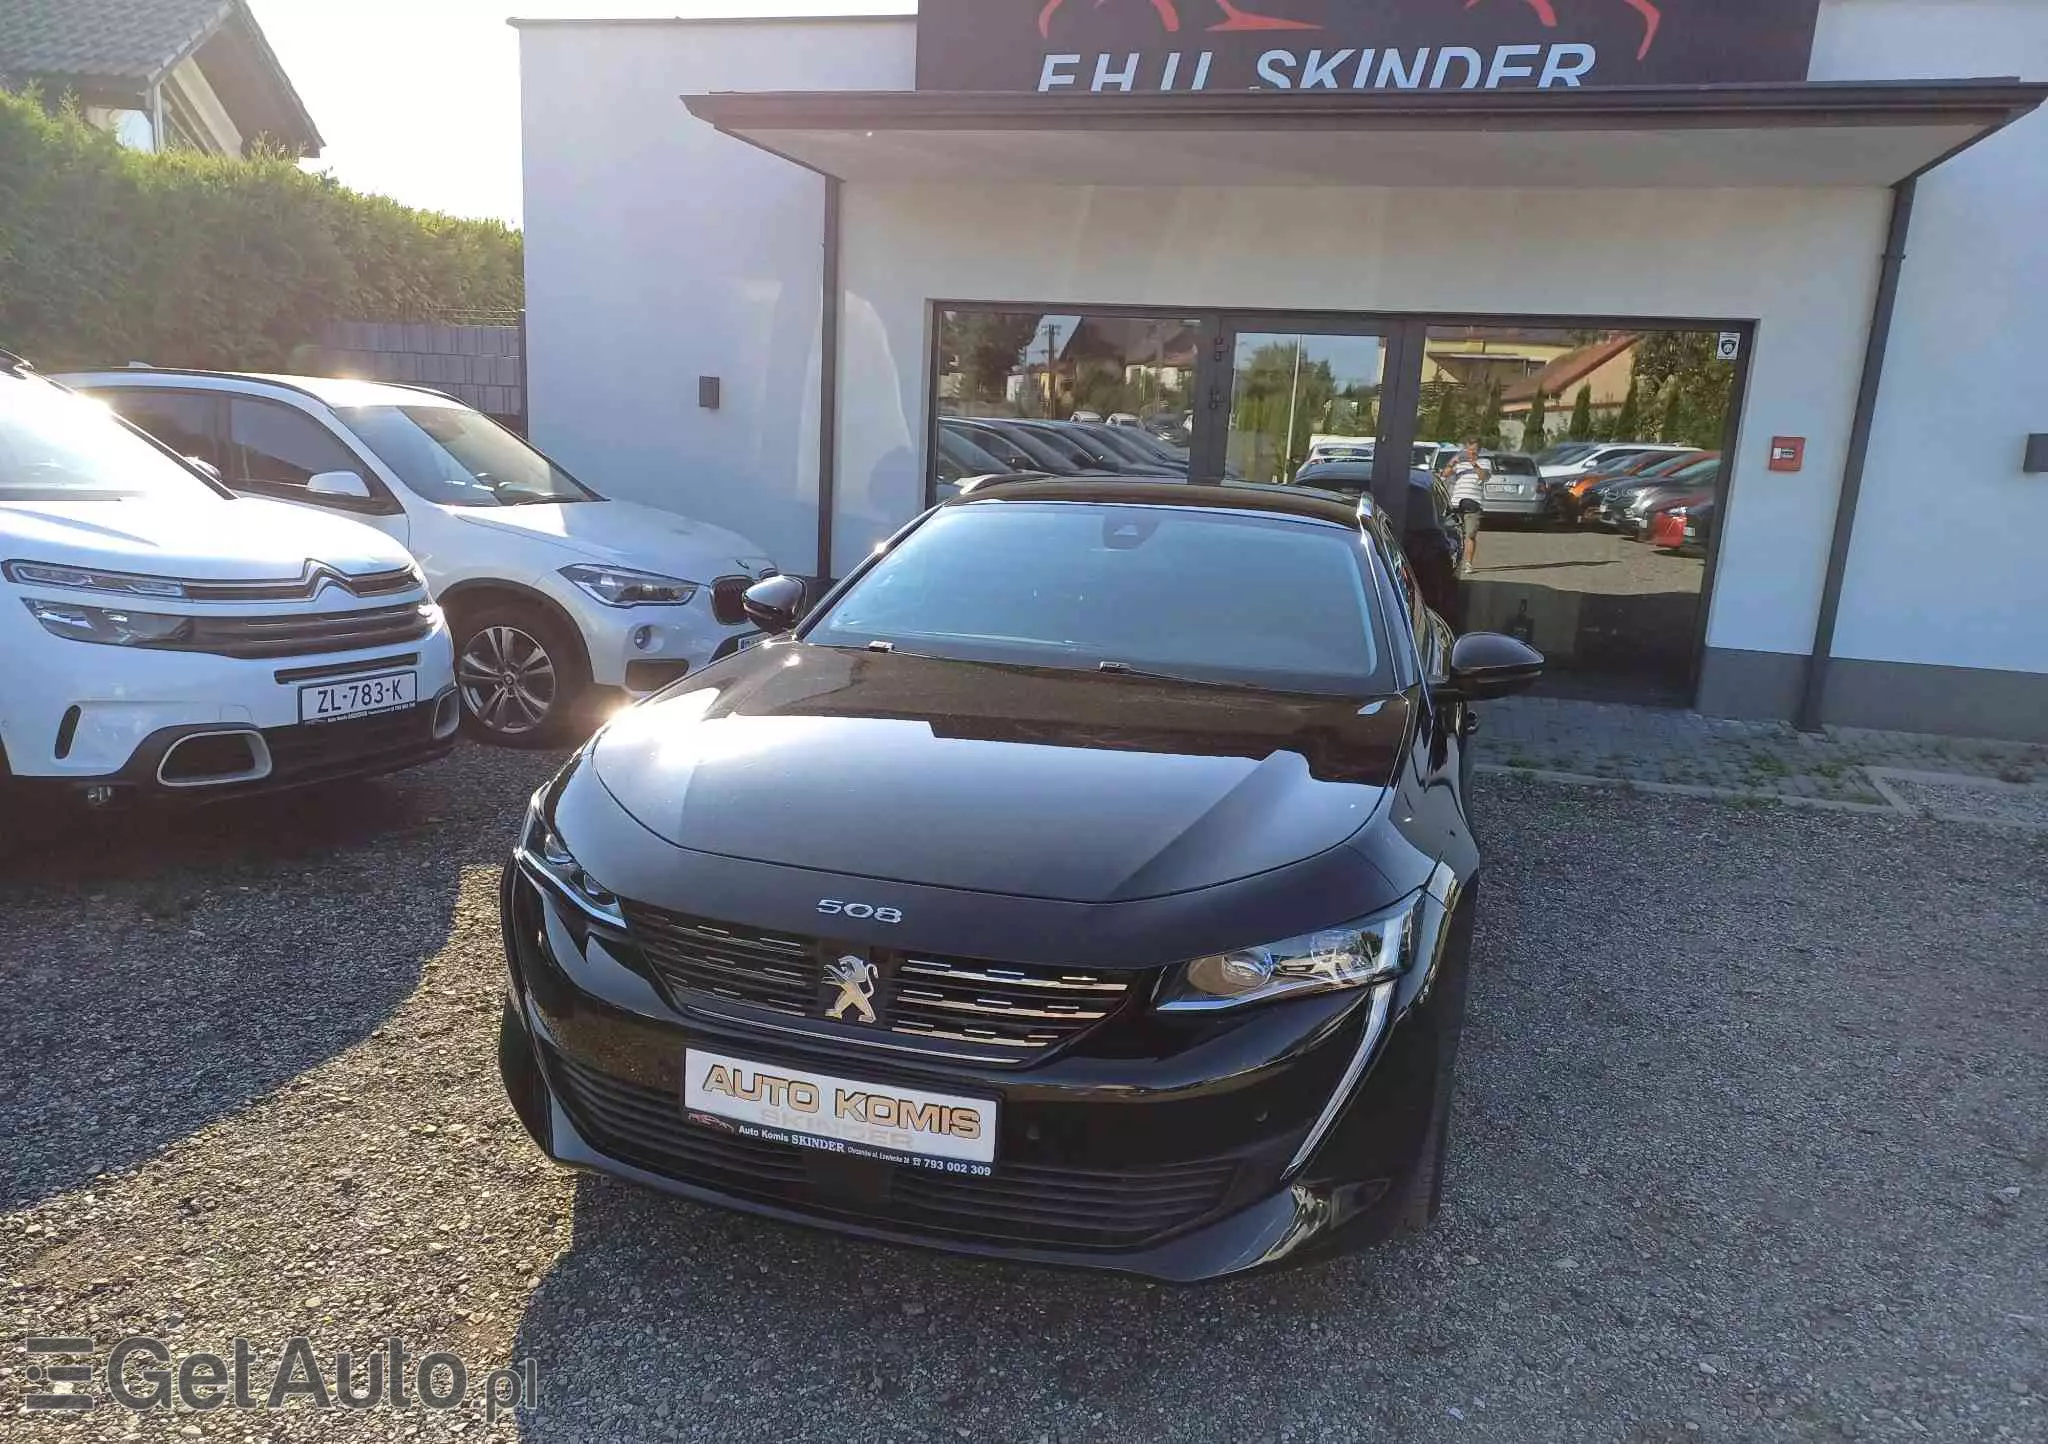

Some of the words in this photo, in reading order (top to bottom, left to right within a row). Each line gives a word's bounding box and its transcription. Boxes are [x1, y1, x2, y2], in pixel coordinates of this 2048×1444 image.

[317, 679, 402, 713] ZL-783-K
[816, 899, 903, 923] 508
[702, 1063, 820, 1114] AUTO
[834, 1087, 981, 1140] KOMIS
[760, 1108, 914, 1149] SKINDER
[739, 1125, 759, 1137] Auto
[761, 1129, 789, 1142] Komis
[791, 1134, 845, 1153] SKINDER
[923, 1158, 944, 1170] 793
[946, 1162, 968, 1173] 002
[970, 1165, 992, 1176] 309
